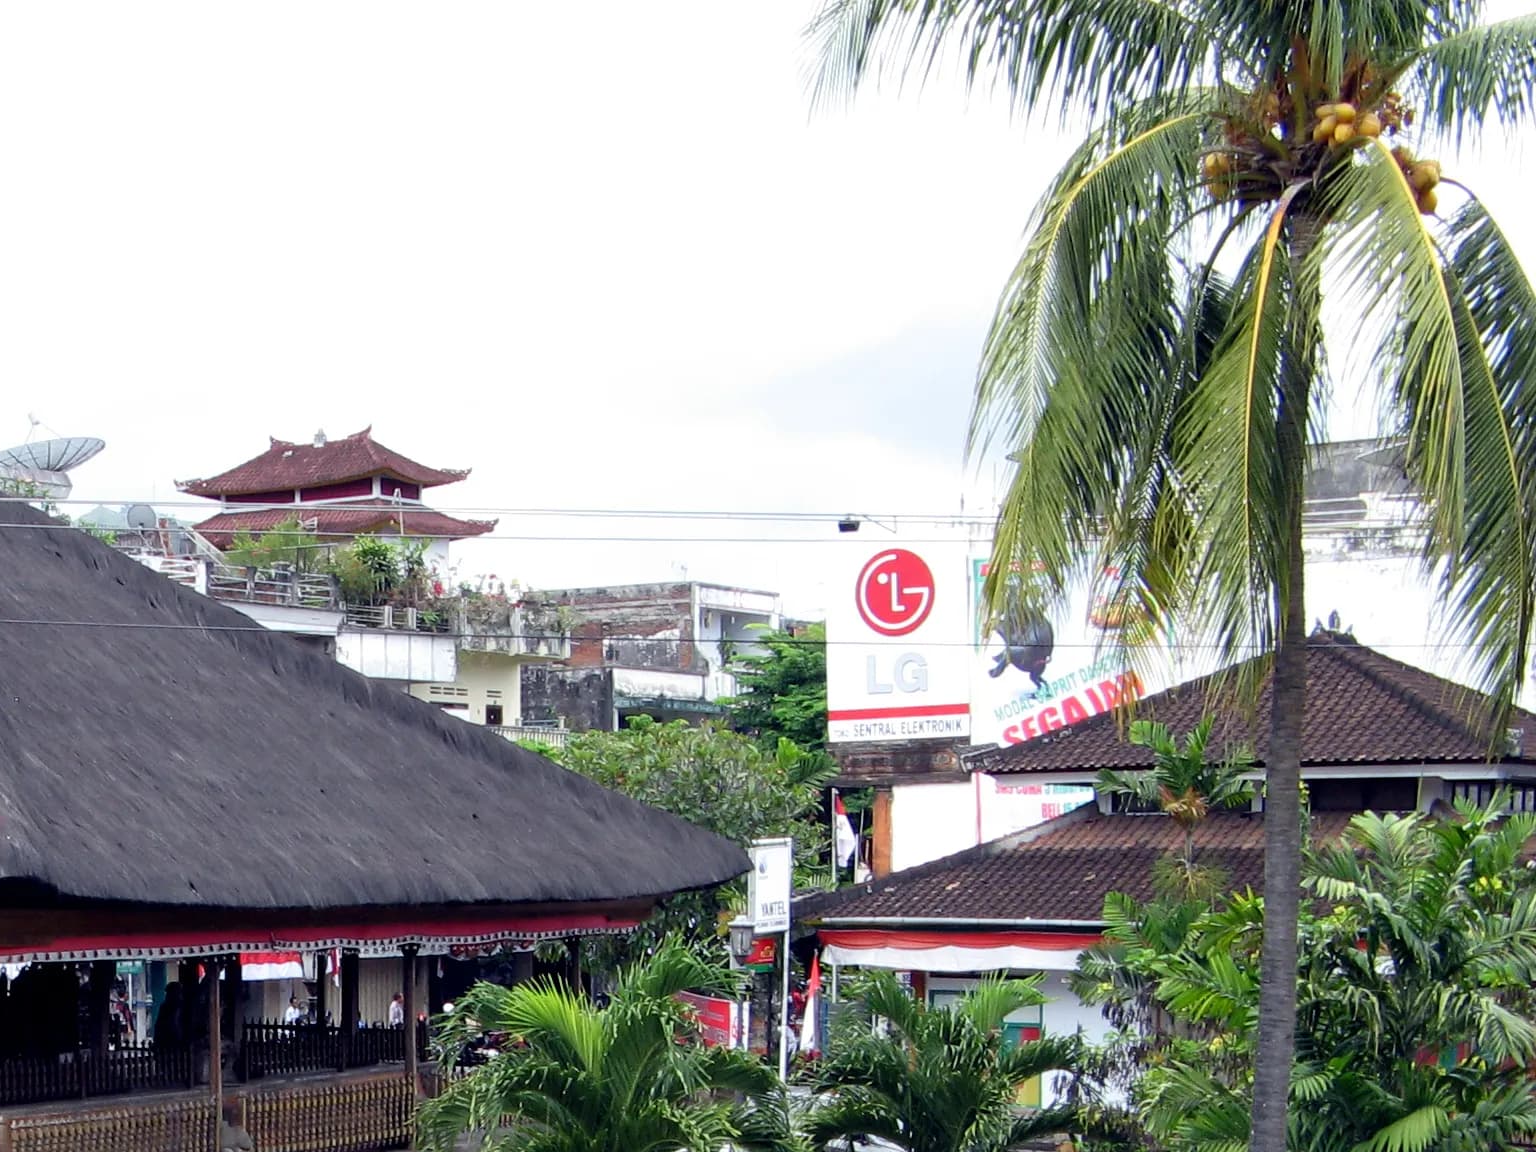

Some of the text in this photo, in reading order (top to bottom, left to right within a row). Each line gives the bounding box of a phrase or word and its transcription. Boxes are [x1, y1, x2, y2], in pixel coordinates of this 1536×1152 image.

[866, 651, 929, 695] LG
[994, 695, 1035, 722] MODAL
[854, 722, 896, 737] SENTRAL
[901, 718, 963, 735] ELEKTRONIK
